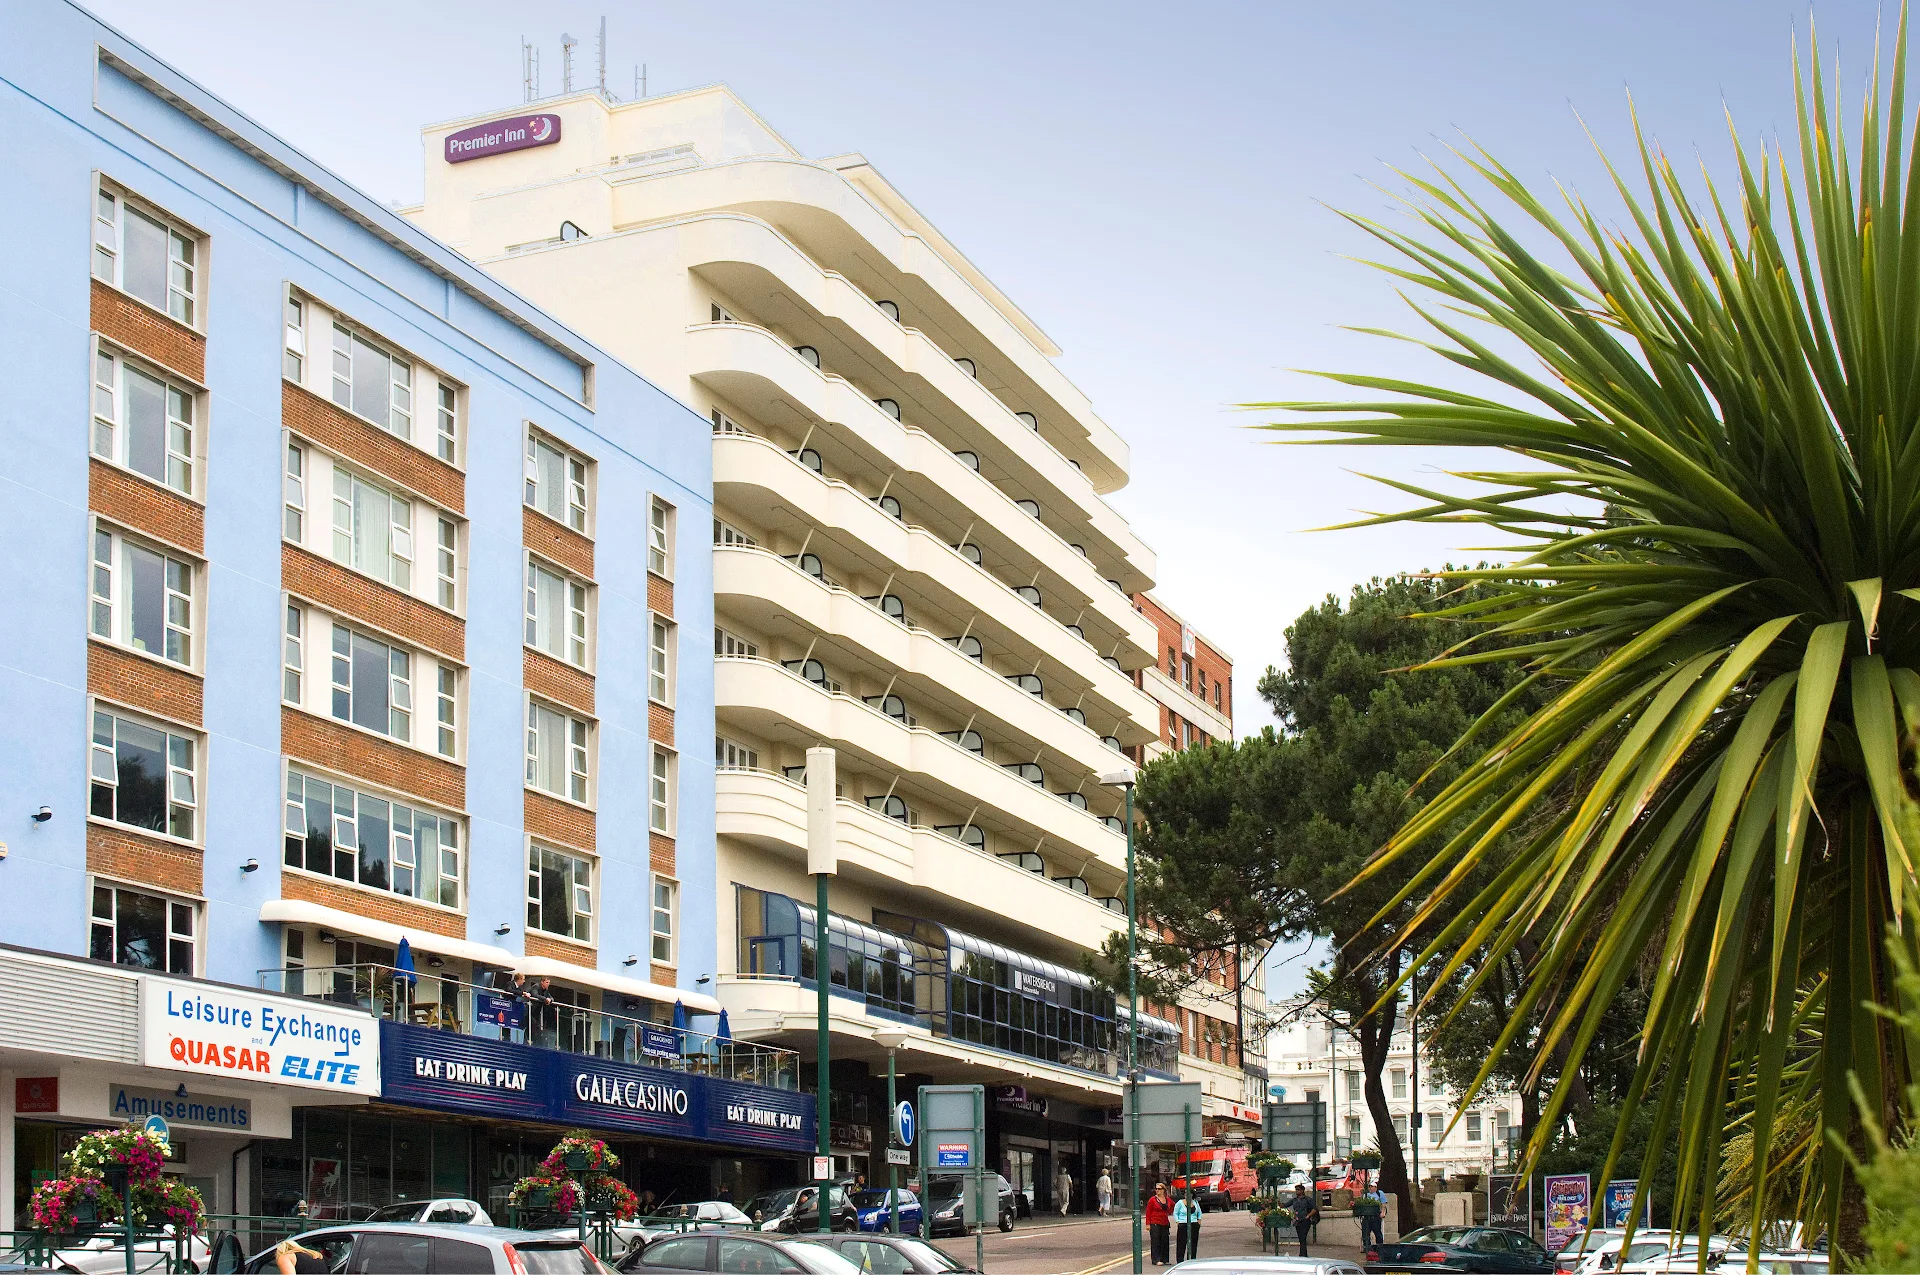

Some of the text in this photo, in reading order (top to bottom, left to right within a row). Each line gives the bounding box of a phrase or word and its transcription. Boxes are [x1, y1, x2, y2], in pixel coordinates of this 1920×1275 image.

[450, 128, 525, 154] Premier Inn
[168, 990, 361, 1057] Leisure Exchange
[251, 1036, 263, 1045] and
[169, 1034, 361, 1085] QUASAR ELITE
[415, 1056, 528, 1091] EAT DRINK PLAY
[114, 1089, 248, 1127] Amusements
[727, 1105, 802, 1130] EAT DRINK PLAY
[889, 1151, 909, 1162] One way
